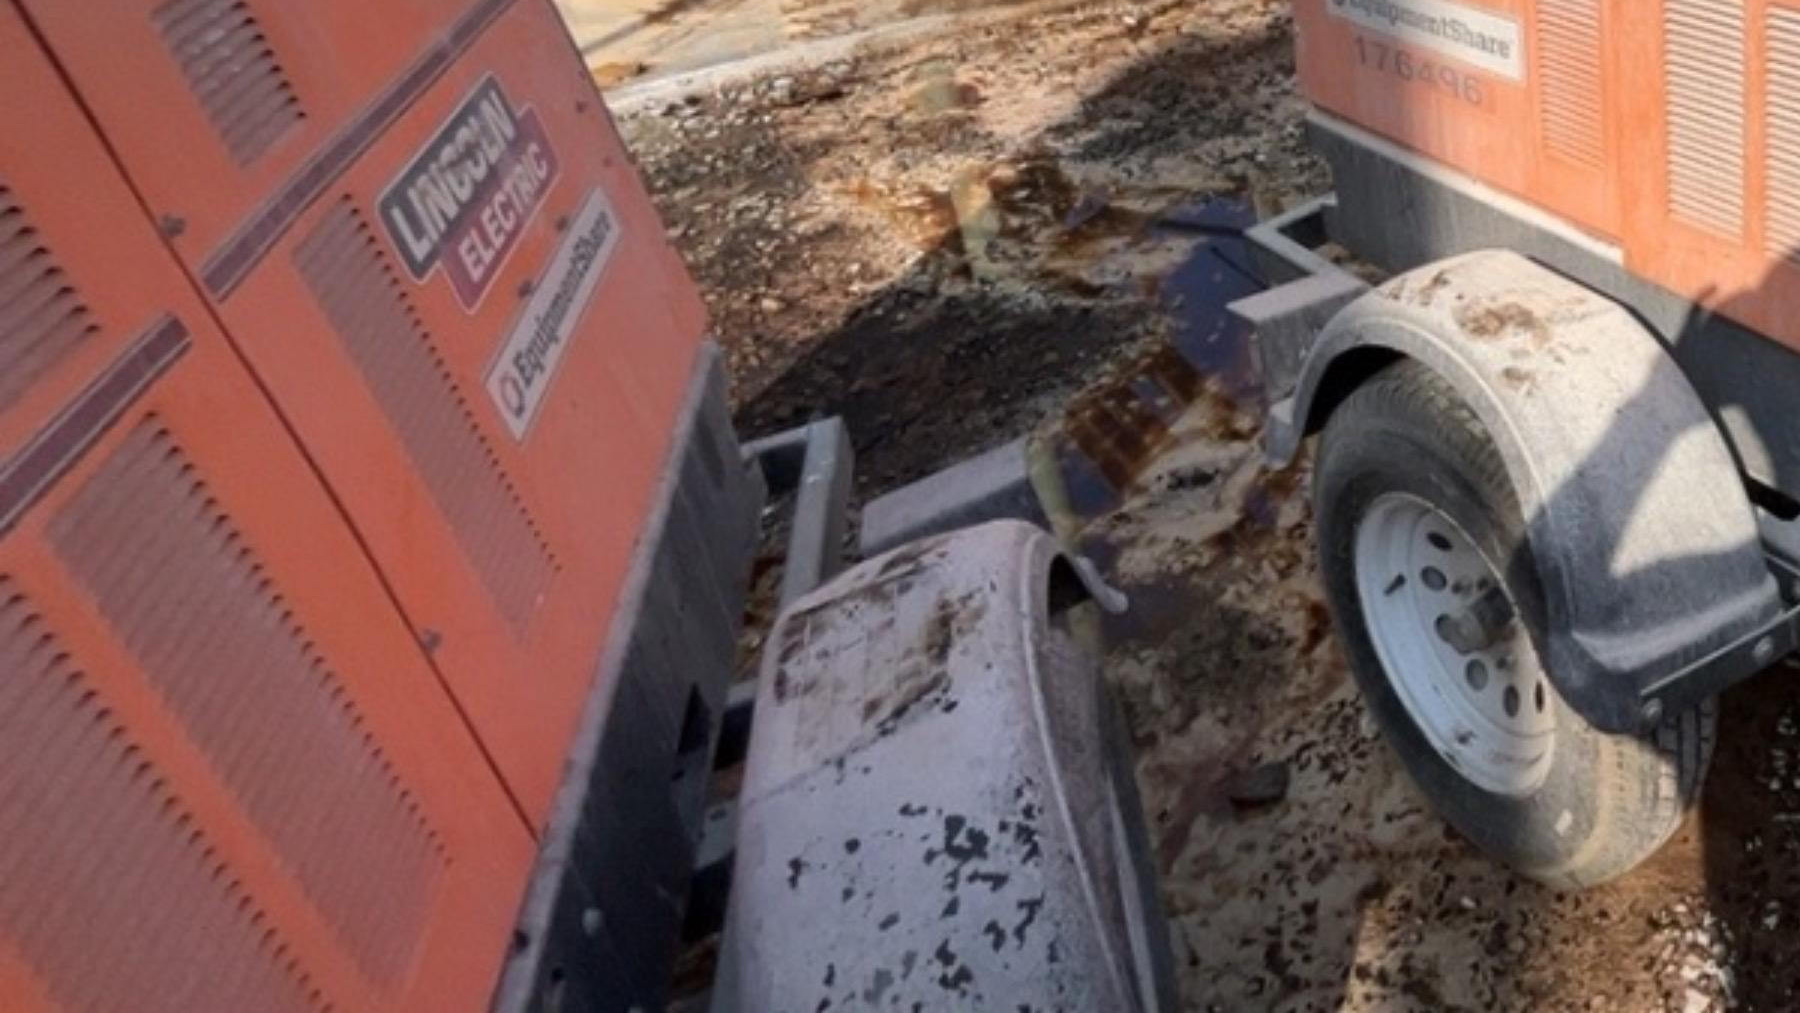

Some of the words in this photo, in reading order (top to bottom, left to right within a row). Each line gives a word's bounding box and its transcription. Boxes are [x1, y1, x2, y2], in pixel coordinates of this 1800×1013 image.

[391, 89, 518, 263] LINCOLN
[428, 143, 548, 283] ELECTRIC
[513, 210, 613, 388] EquipmentShare
